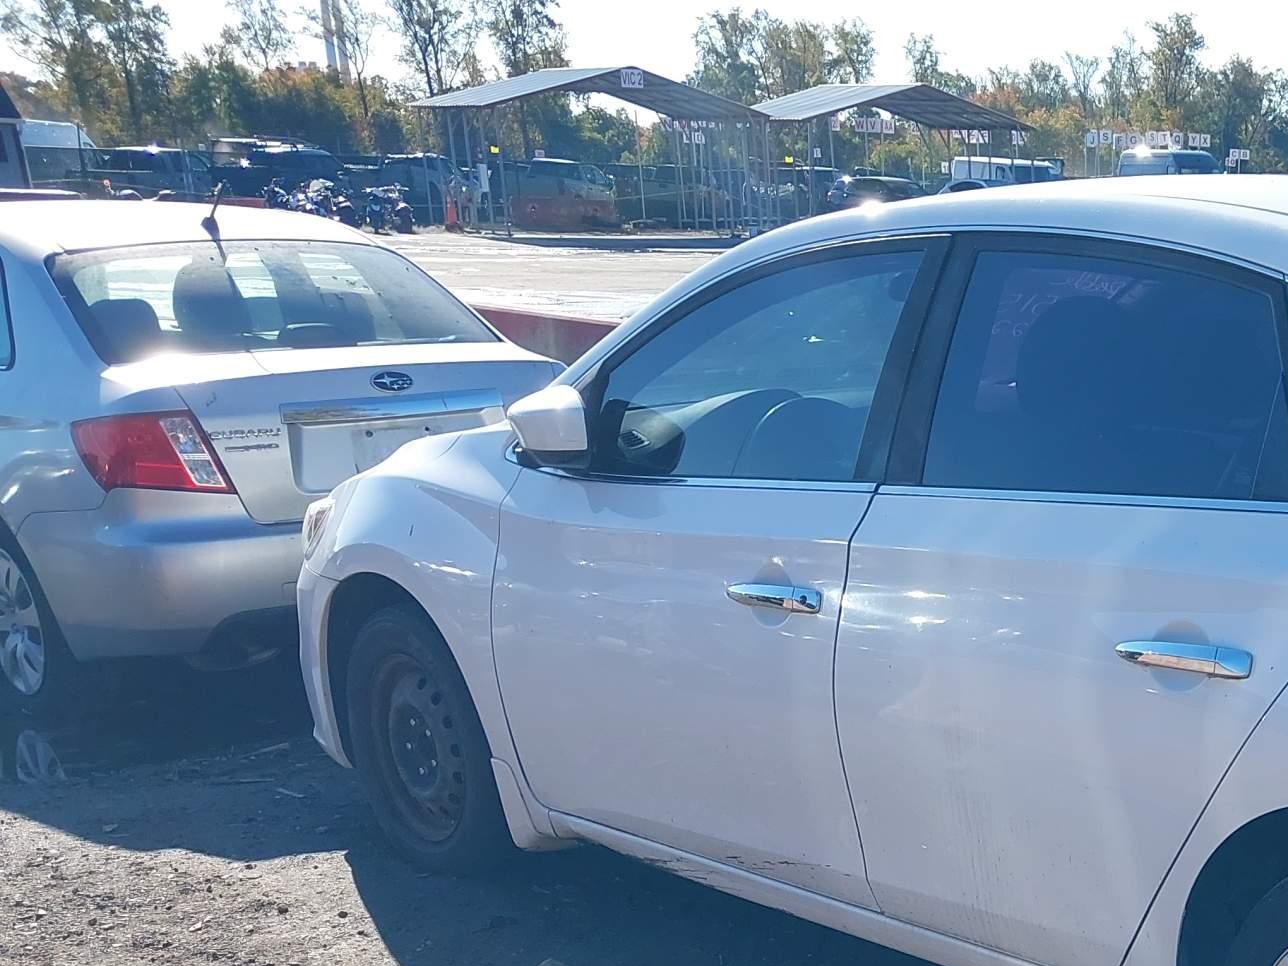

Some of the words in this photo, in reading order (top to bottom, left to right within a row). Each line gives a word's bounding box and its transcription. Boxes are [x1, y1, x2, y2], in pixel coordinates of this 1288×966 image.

[621, 71, 636, 86] VIC
[636, 71, 642, 86] 2
[1102, 132, 1109, 142] S
[1160, 133, 1168, 142] T
[1174, 134, 1181, 146] Q
[1191, 135, 1198, 145] Y
[1202, 135, 1209, 146] X
